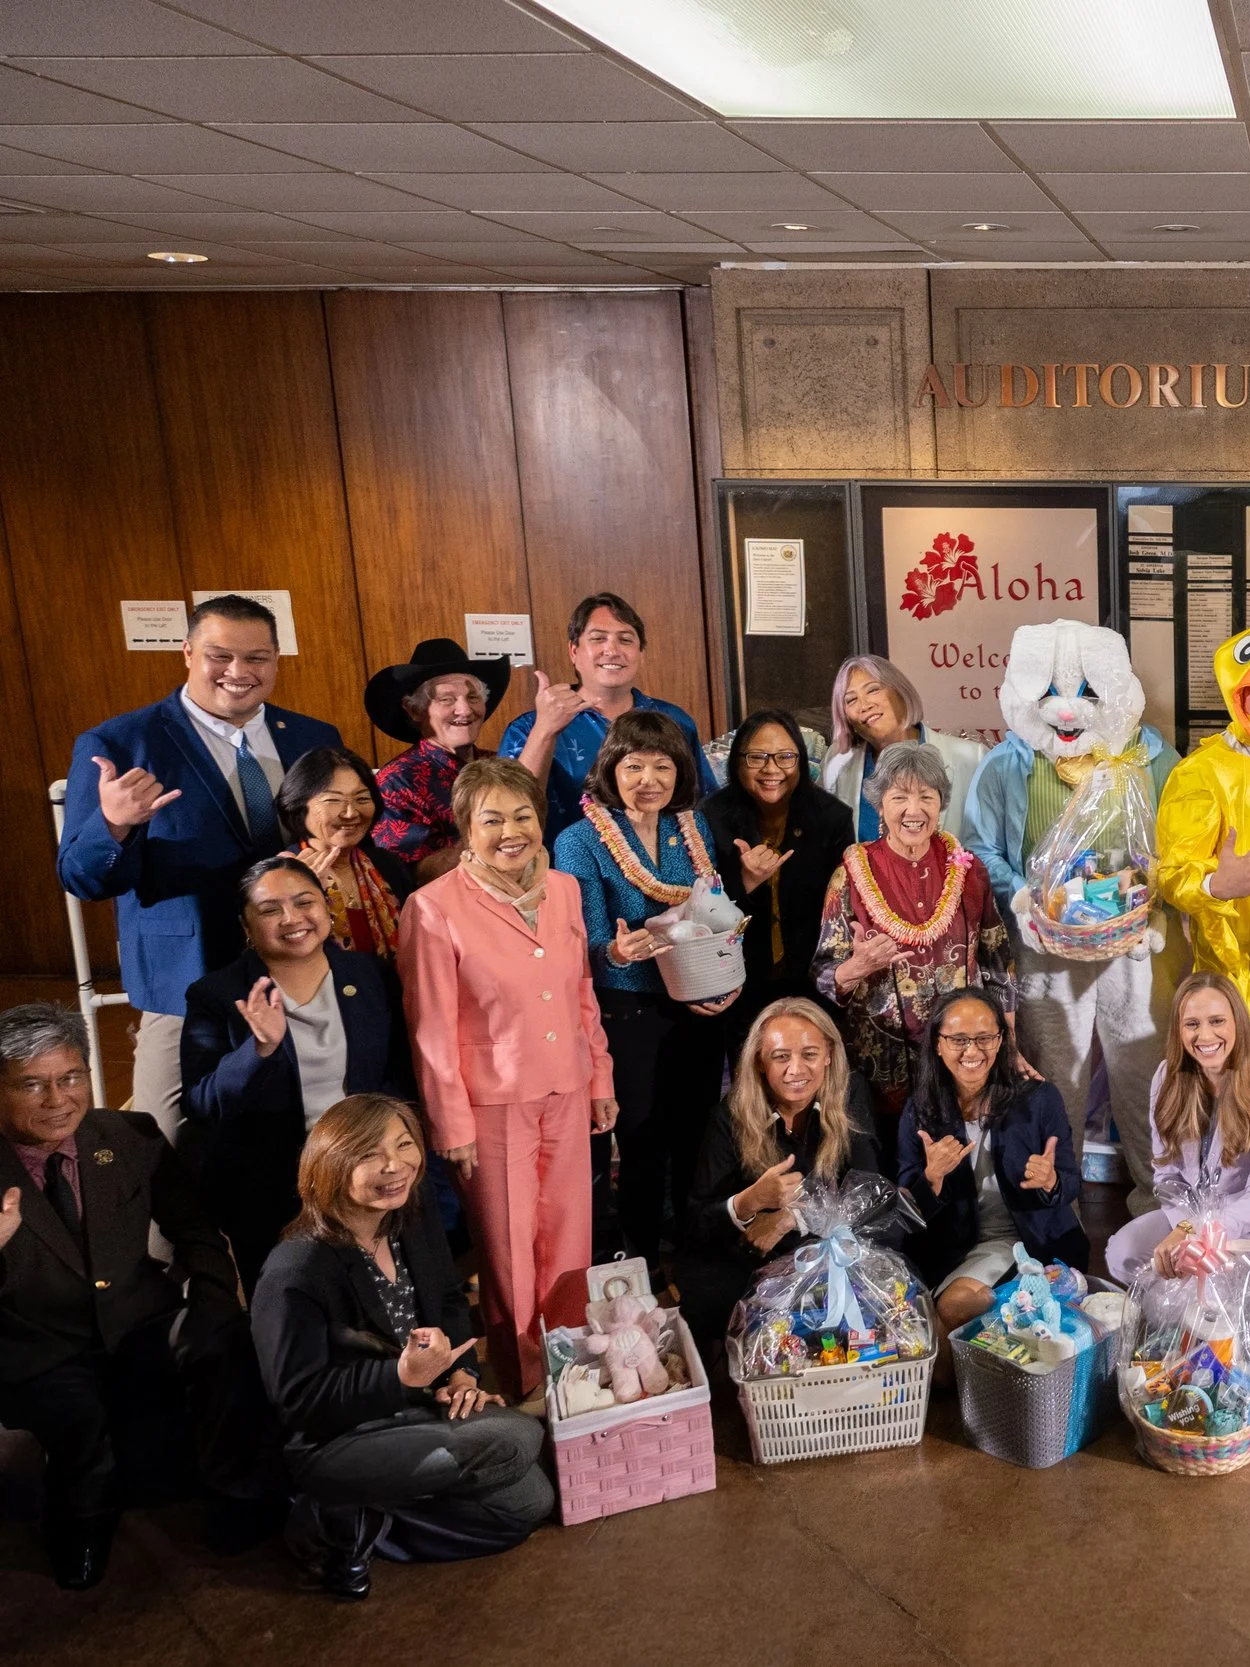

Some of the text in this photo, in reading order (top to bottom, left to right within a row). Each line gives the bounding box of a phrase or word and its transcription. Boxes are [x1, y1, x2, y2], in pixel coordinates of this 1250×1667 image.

[957, 560, 1085, 600] Aloha
[960, 685, 982, 700] to
[1168, 1403, 1200, 1422] Wishing
[1178, 1414, 1195, 1426] you
